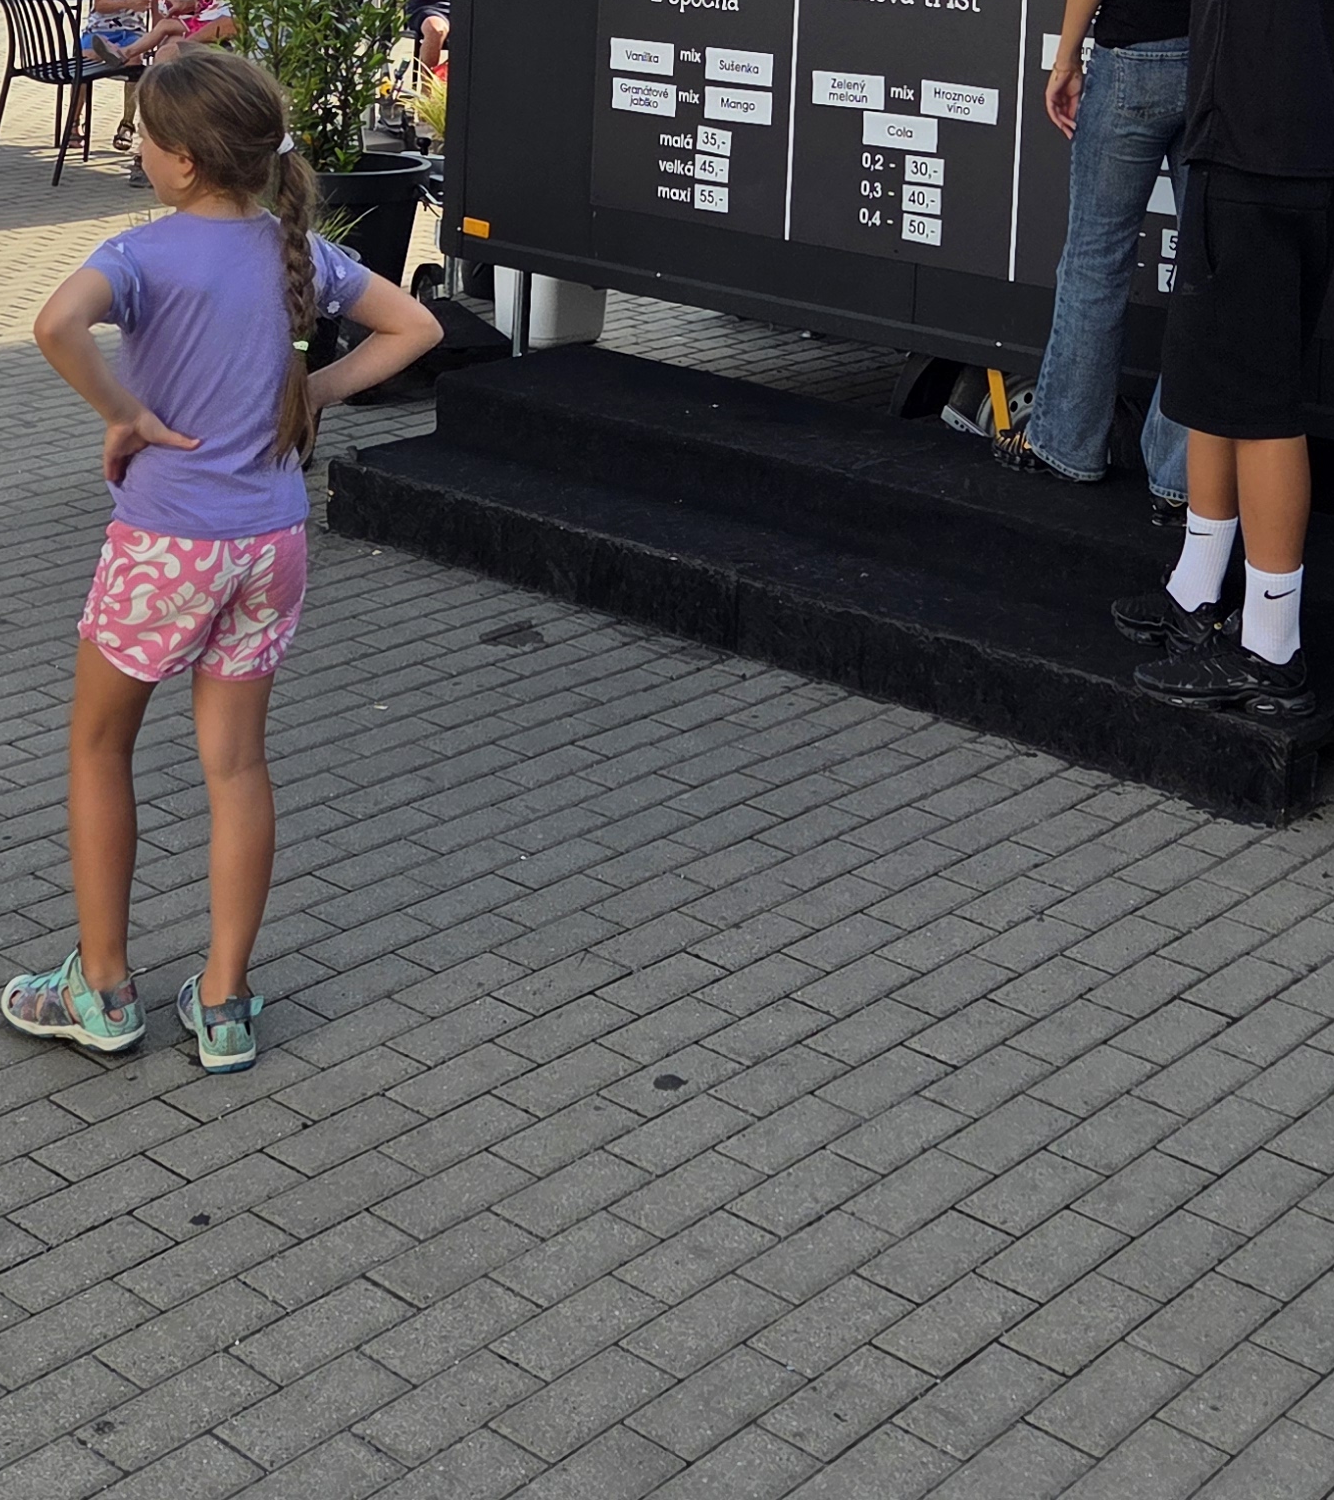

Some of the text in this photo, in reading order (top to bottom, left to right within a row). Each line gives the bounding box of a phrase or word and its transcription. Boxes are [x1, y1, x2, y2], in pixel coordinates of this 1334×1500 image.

[679, 48, 702, 64] mix
[719, 60, 760, 75] Sušenka
[620, 82, 669, 99] Granátové
[830, 78, 866, 93] Zelený
[890, 85, 915, 101] mix
[678, 89, 756, 113] mix Mango
[828, 92, 868, 104] meloun
[933, 88, 985, 106] Hroznové
[946, 102, 971, 116] víno
[659, 131, 726, 150] malá 35,-
[887, 125, 914, 139] Cola
[658, 159, 724, 178] velká 45,-
[861, 152, 884, 171] 0,2
[910, 161, 938, 180] 30,-
[657, 185, 724, 207] maxi 55,-
[860, 180, 882, 199] 0,3
[907, 191, 936, 209] 40,-
[859, 208, 881, 227] 0,4
[907, 220, 936, 238] 50,-
